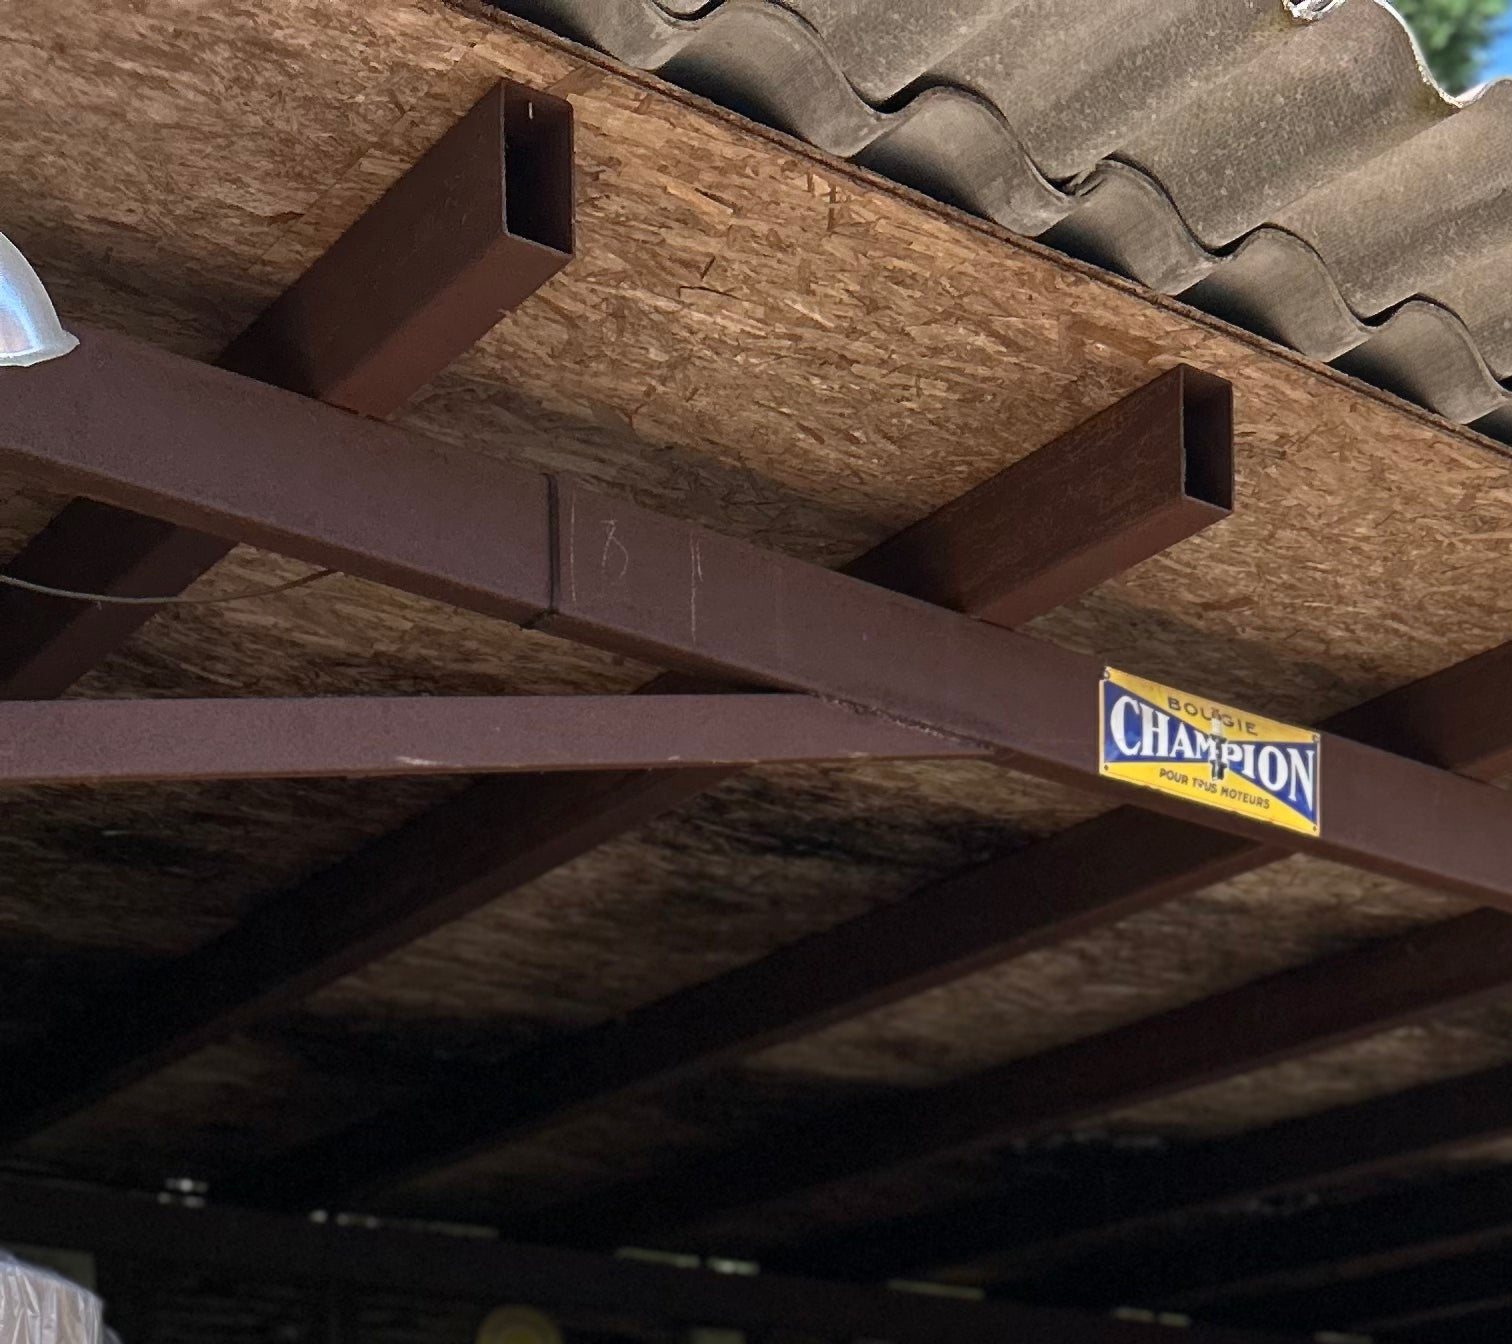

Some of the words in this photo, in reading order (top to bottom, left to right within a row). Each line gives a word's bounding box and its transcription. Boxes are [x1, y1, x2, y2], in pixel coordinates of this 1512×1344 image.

[1168, 697, 1258, 736] BOUGIE
[1110, 695, 1315, 811] CHAMPION
[1159, 767, 1188, 785] POUR
[1220, 784, 1270, 809] MOTEURS
